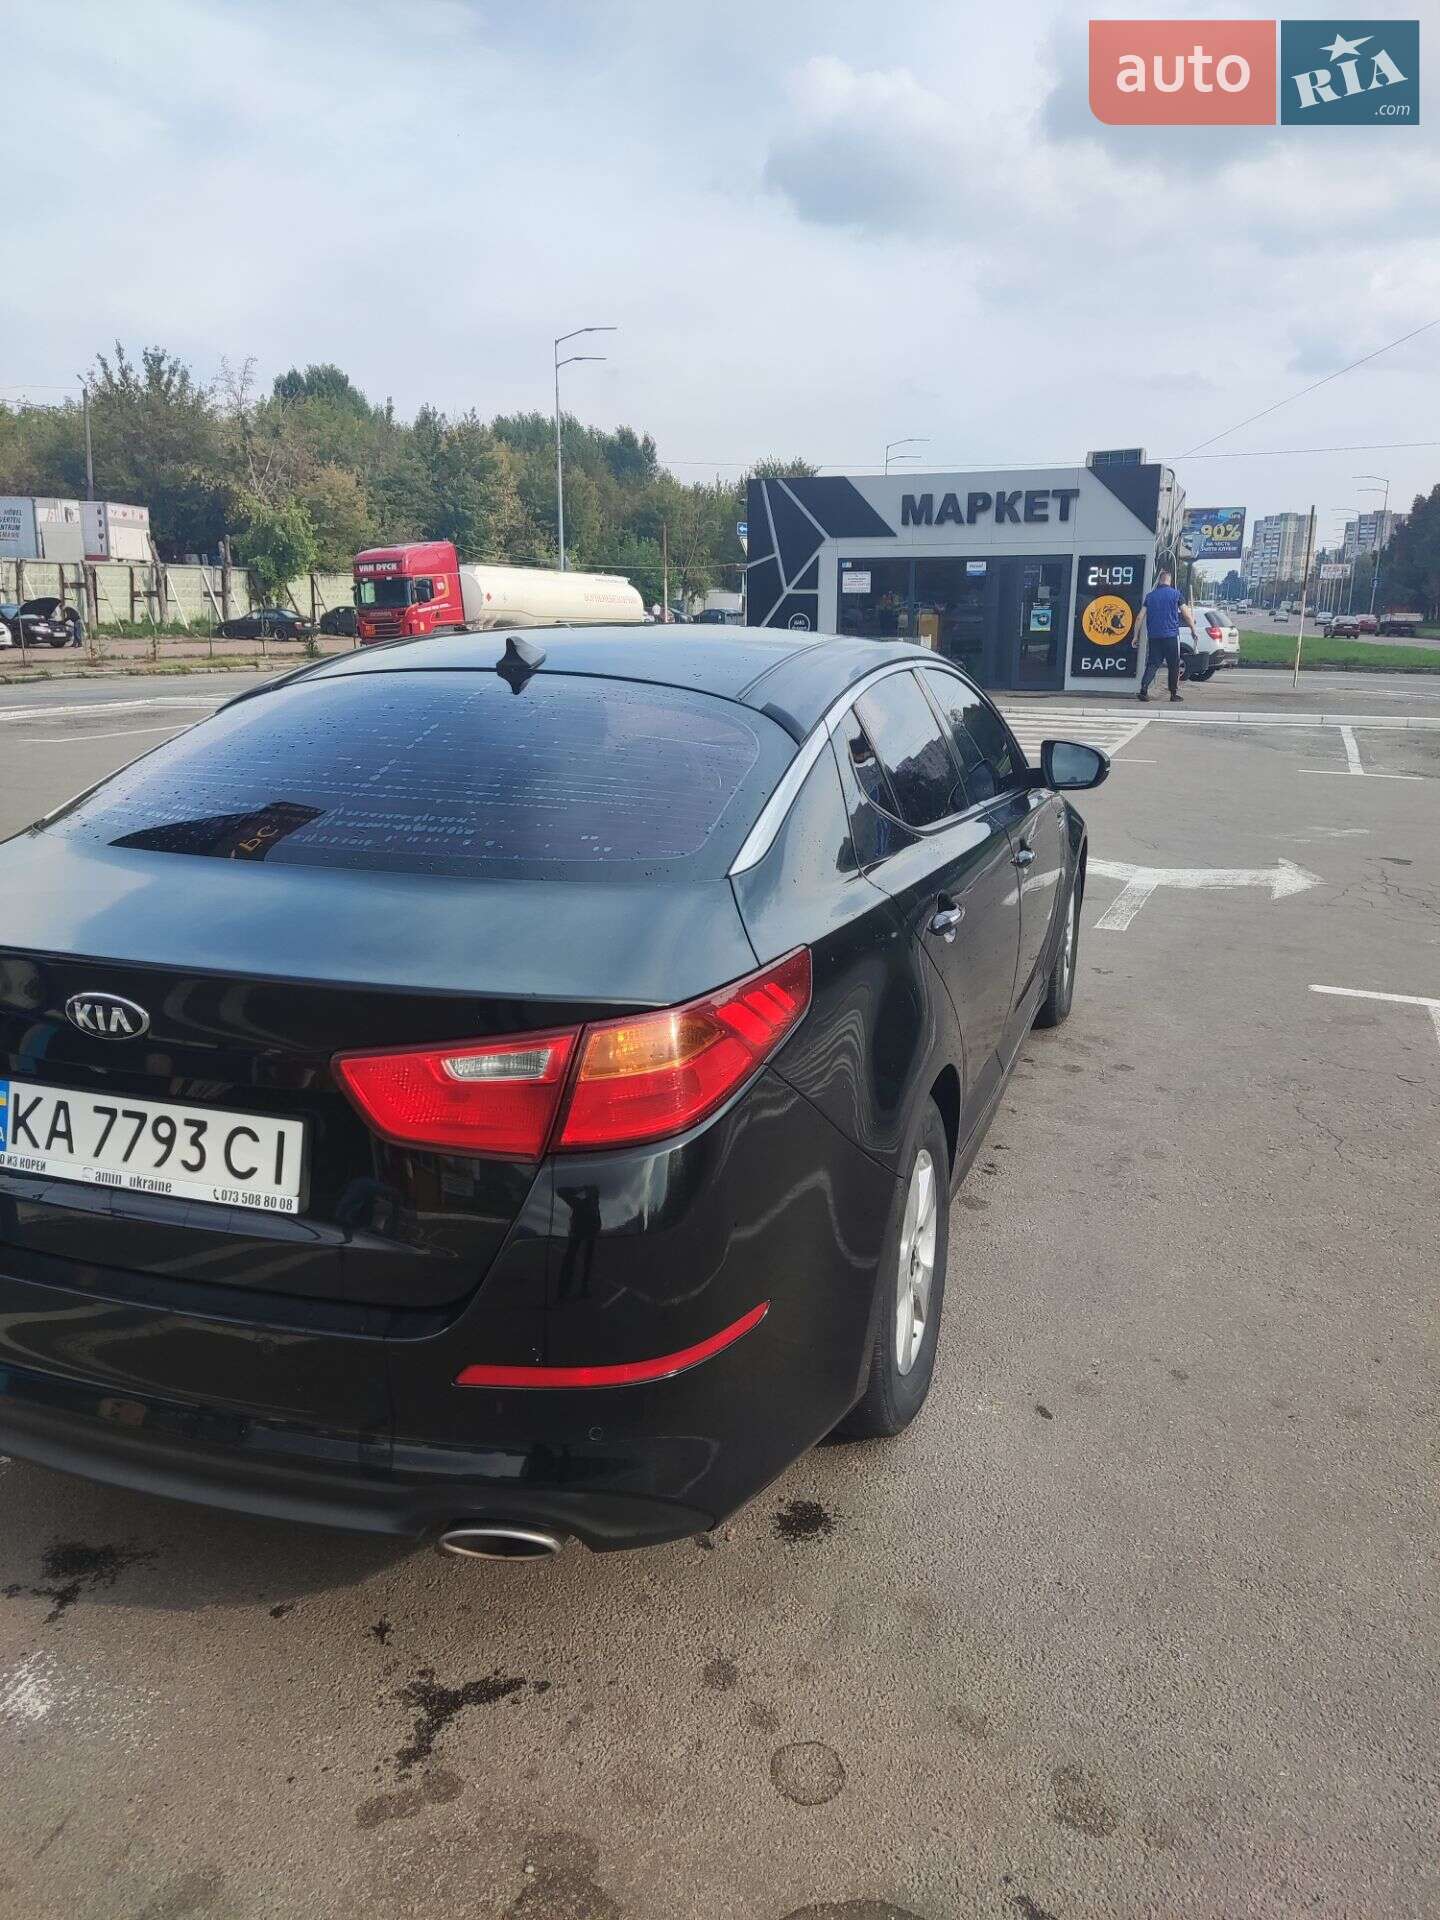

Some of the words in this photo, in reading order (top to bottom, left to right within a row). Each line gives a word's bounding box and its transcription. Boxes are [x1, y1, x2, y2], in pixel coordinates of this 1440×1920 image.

[901, 488, 1080, 526] МАРКЕТ
[1200, 523, 1241, 541] 90%
[358, 563, 374, 573] VAN
[1088, 566, 1134, 586] 24.99
[1081, 658, 1127, 671] БАРС
[74, 1002, 134, 1033] KIA
[11, 1093, 75, 1154] KA
[93, 1105, 208, 1172] 7793
[221, 1189, 239, 1203] 073
[263, 1195, 277, 1208] 80
[279, 1198, 293, 1211] 08
